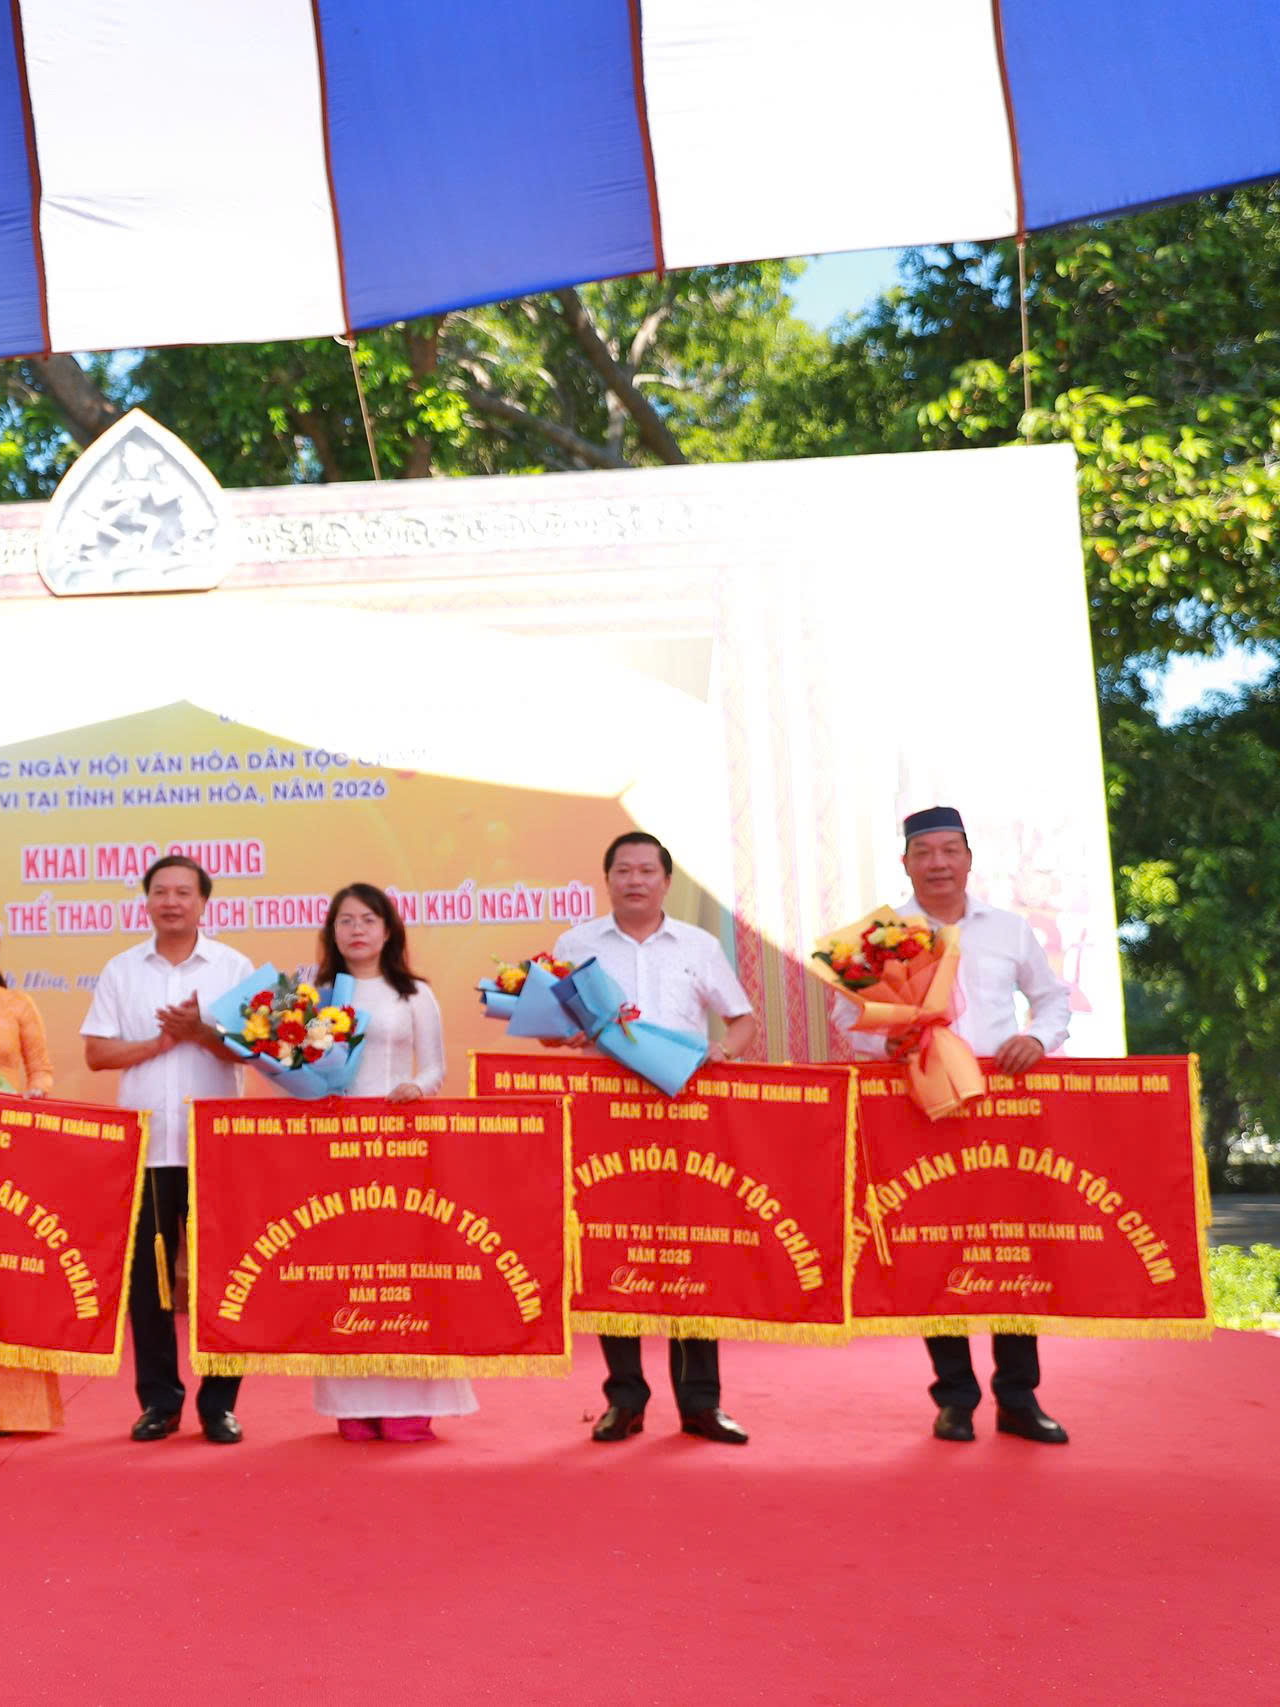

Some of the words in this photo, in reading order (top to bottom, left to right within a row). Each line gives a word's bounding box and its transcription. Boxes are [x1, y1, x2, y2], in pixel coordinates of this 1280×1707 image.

[19, 755, 80, 776] NGÀY
[89, 753, 129, 779] HỘI
[136, 751, 182, 773] VĂN
[191, 750, 239, 770] HÓA
[248, 748, 295, 769] DÂN
[27, 791, 58, 812] TẠI
[66, 784, 114, 807] TỈNH
[123, 780, 201, 806] KHÁNH
[209, 783, 264, 803] HÒA,
[273, 780, 324, 800] NĂM
[334, 780, 385, 798] 2026
[24, 848, 86, 880] KHAI
[9, 893, 47, 931] THỂ
[58, 905, 112, 930] THAO
[254, 899, 329, 925] TRONG
[426, 882, 472, 920] KHỔ
[481, 885, 543, 919] NGÀY
[553, 885, 591, 923] HỘI
[610, 1101, 641, 1119] BAN
[330, 1142, 360, 1159] BAN
[364, 1136, 383, 1157] TỔ
[386, 1138, 428, 1157] CHỨC
[575, 1148, 624, 1188] VĂN
[629, 1144, 679, 1172] HÓA
[685, 1152, 736, 1189] DÂN
[735, 1175, 781, 1221] TỘC
[773, 1218, 825, 1293] CHĂM
[903, 1152, 956, 1190] VĂN
[961, 1140, 1010, 1171] HÓA
[1018, 1147, 1074, 1184] DÂN
[1076, 1168, 1122, 1215] TỘC
[1117, 1210, 1176, 1285] CHĂM
[27, 1204, 69, 1249] TỘC
[59, 1247, 100, 1320] CHĂM
[218, 1254, 263, 1322] NGÀY
[254, 1218, 297, 1260] HỘI
[293, 1193, 345, 1230] VĂN
[350, 1180, 398, 1211] HÓA
[405, 1188, 456, 1224] DÂN
[457, 1210, 502, 1254] TỘC
[496, 1250, 543, 1323] CHĂM
[337, 1265, 351, 1280] VI
